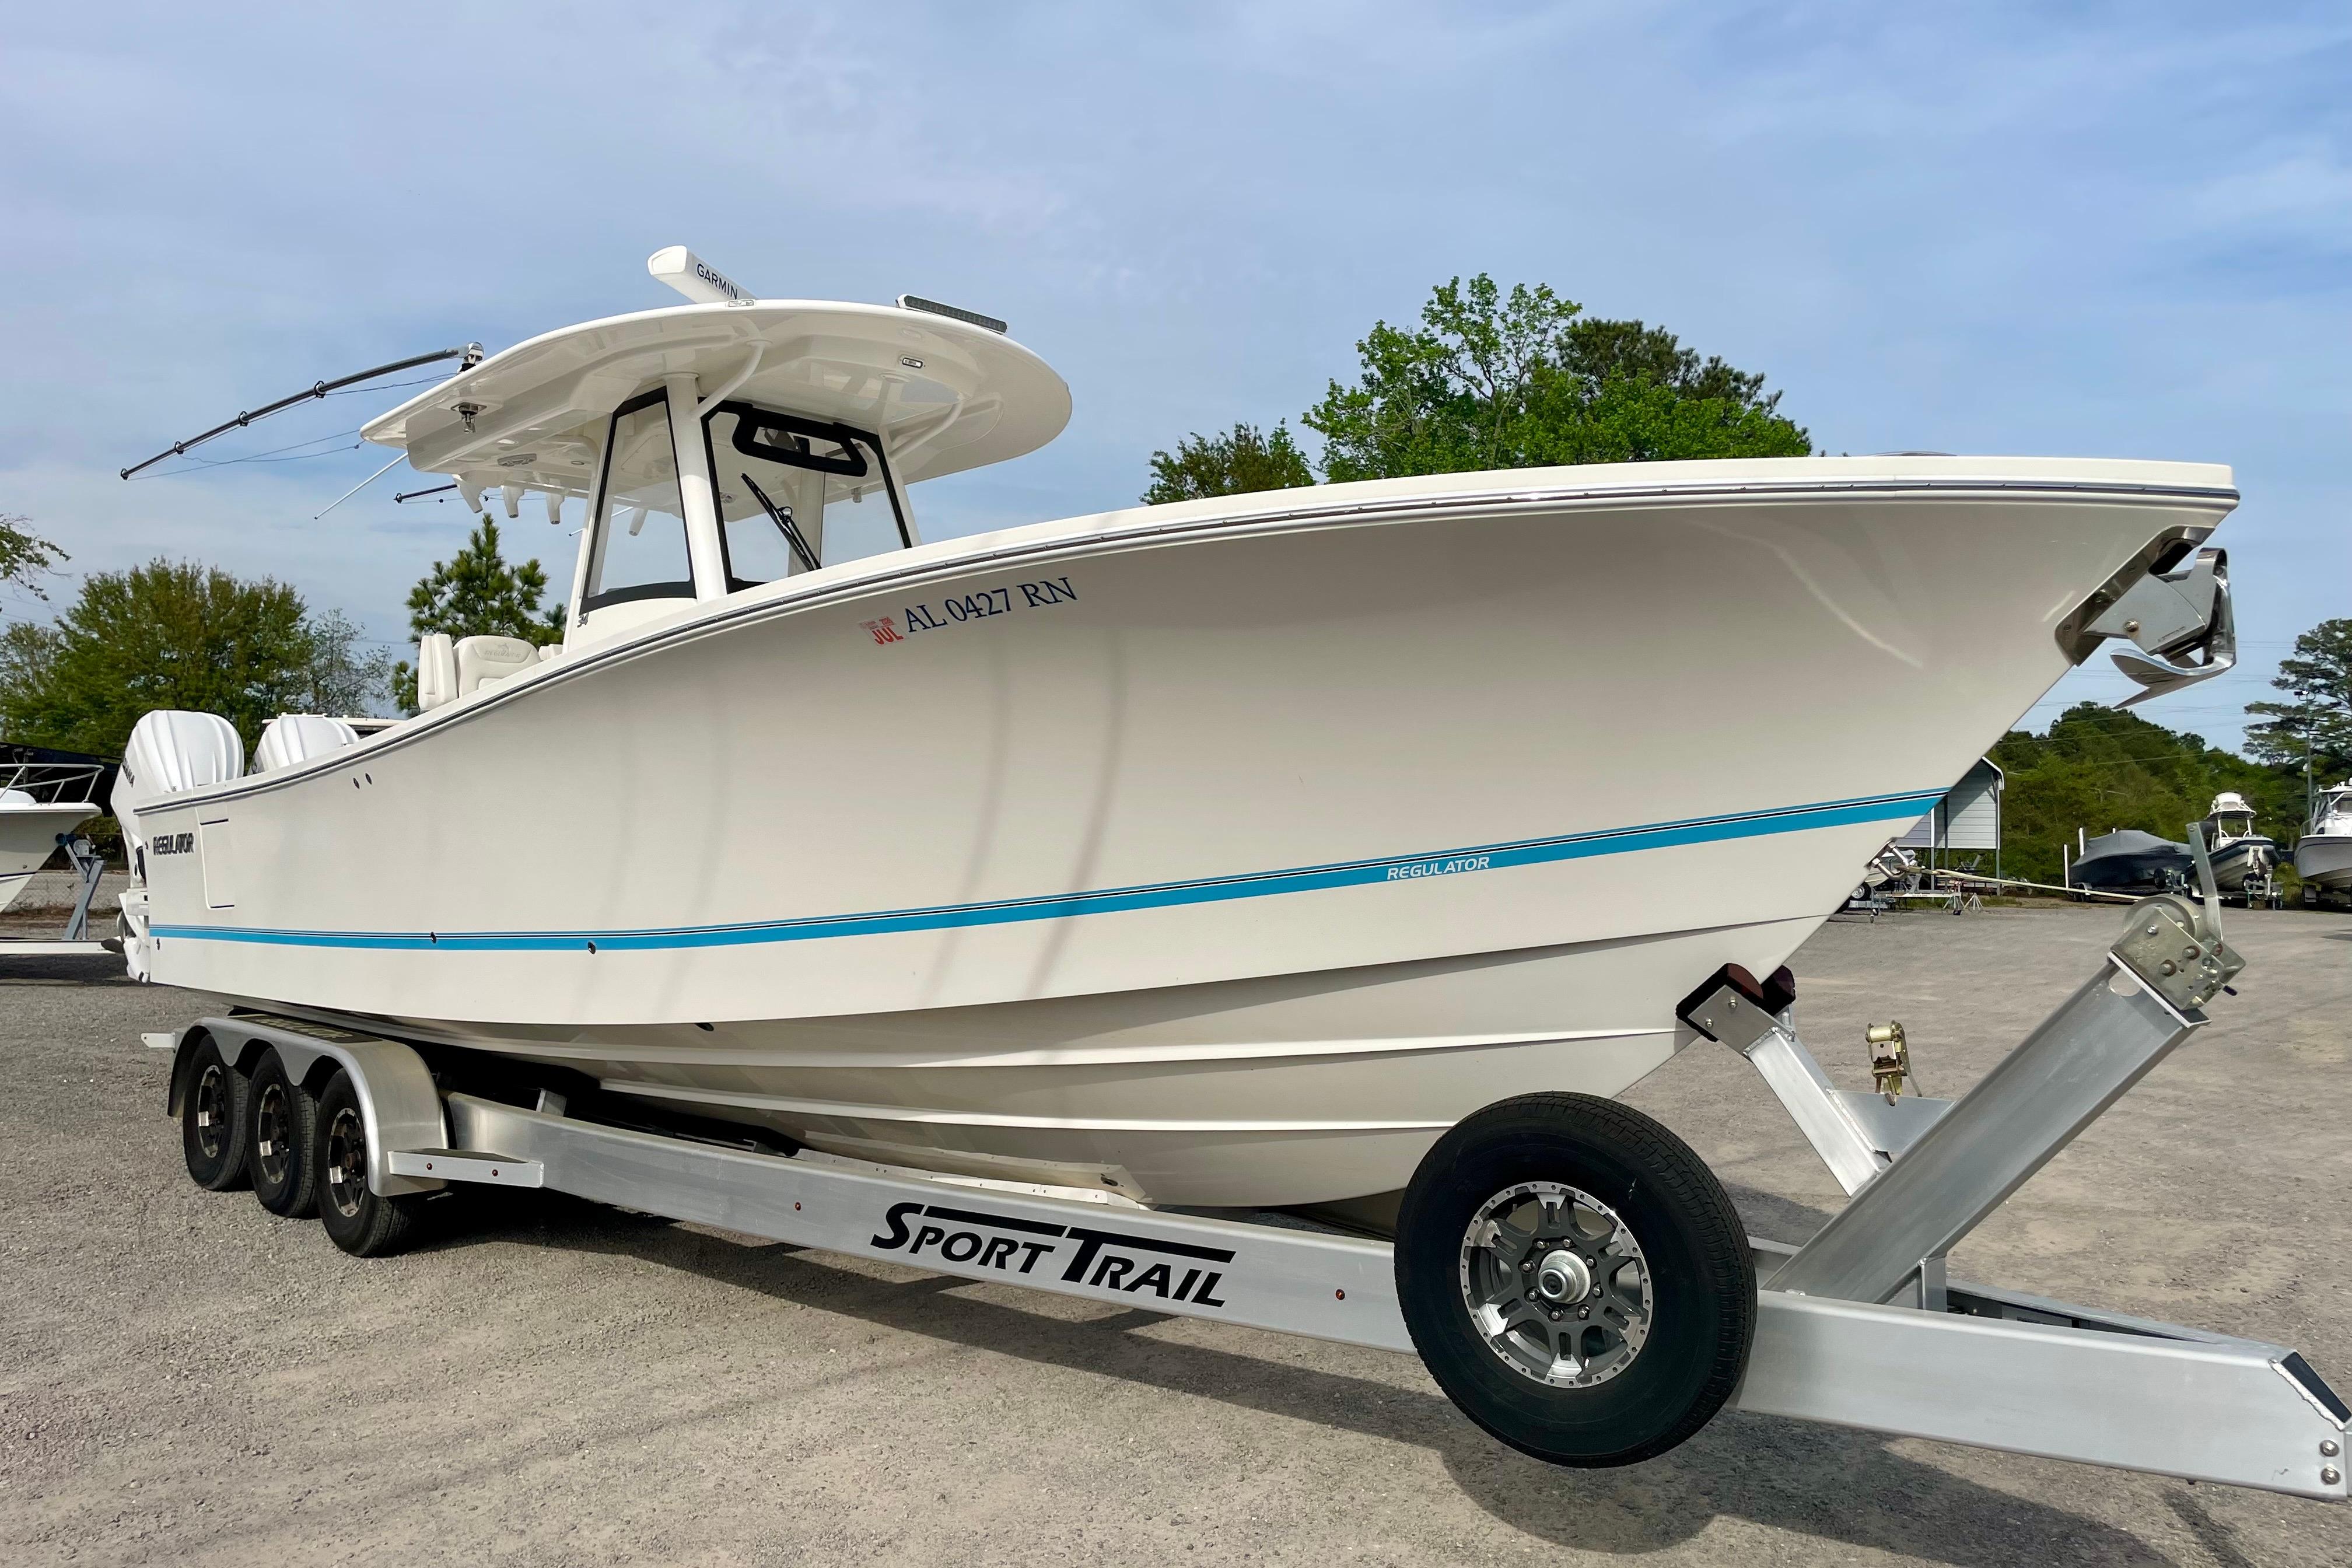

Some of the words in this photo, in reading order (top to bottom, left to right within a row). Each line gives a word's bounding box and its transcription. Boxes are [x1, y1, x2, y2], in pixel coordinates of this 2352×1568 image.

[697, 263, 738, 300] GARMIN
[905, 604, 948, 632] AL
[944, 588, 1012, 621] 0427
[1016, 577, 1077, 607] RN
[872, 626, 904, 645] JUL
[1387, 856, 1490, 880] REGULATOR
